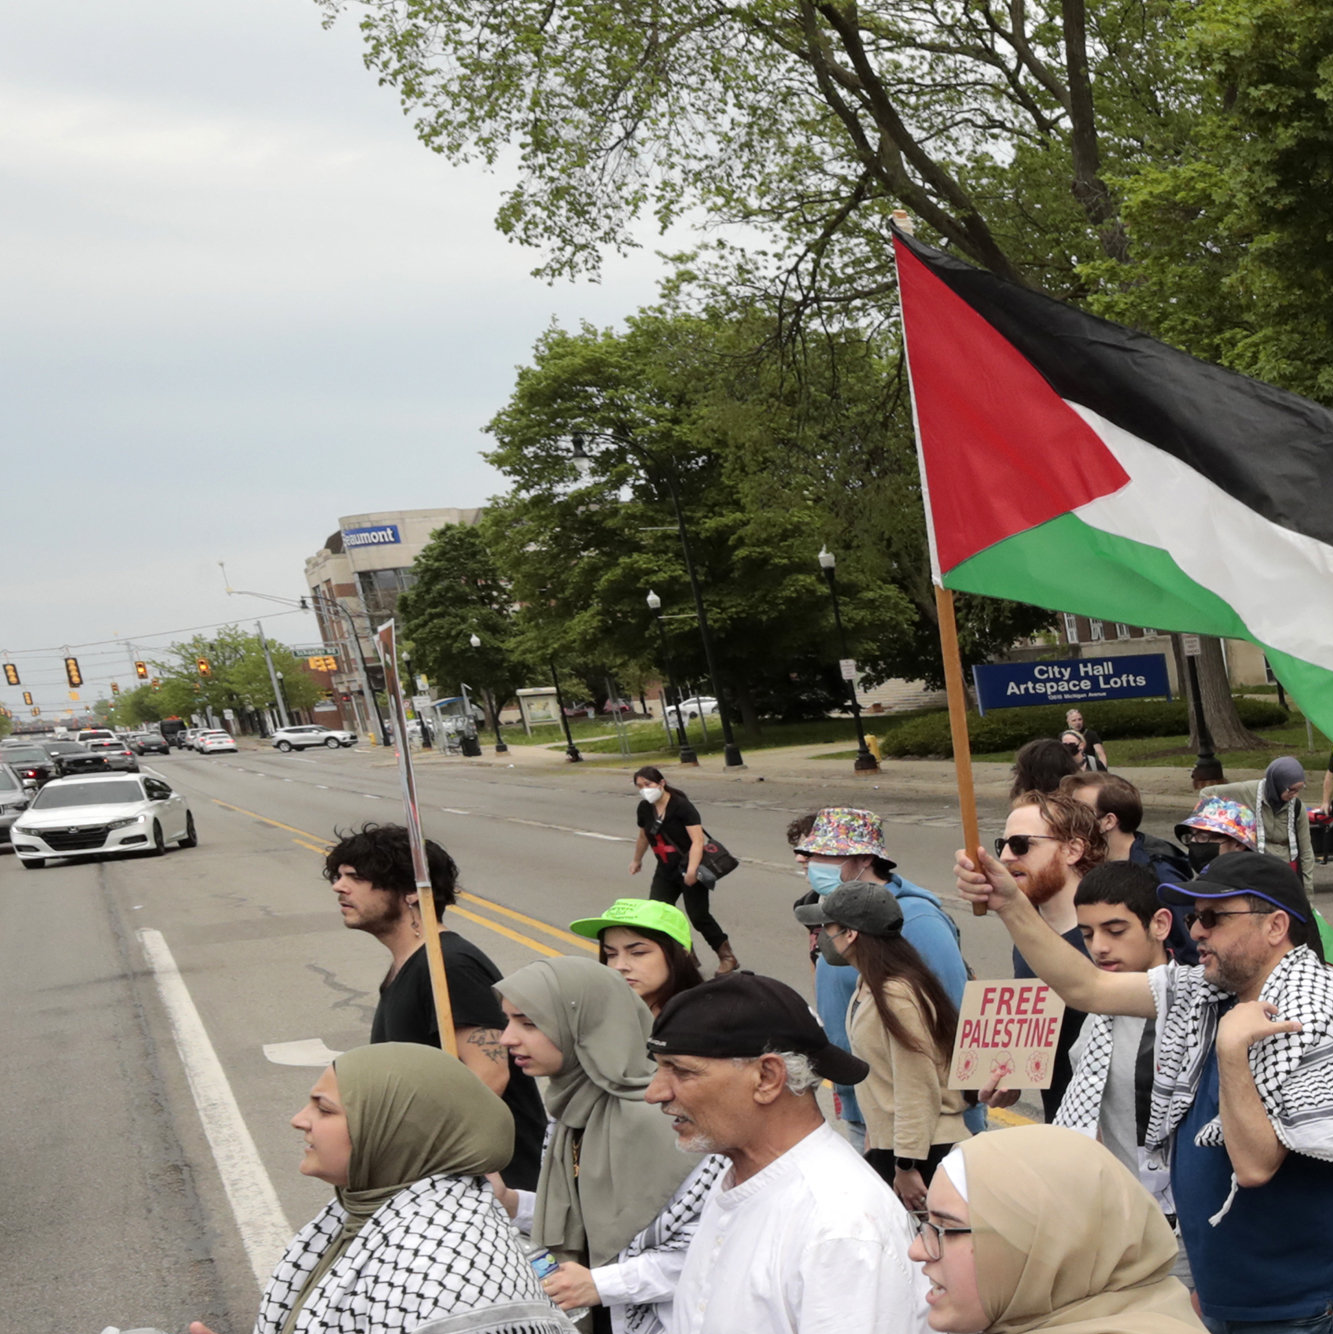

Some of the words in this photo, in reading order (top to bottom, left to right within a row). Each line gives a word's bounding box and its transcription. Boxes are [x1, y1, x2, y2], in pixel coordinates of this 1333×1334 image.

[1034, 665, 1071, 680] City
[1079, 661, 1113, 676] Hall
[1006, 678, 1091, 696] Artspace
[1099, 674, 1146, 689] Lofts
[980, 986, 1050, 1016] FREE
[959, 1017, 1058, 1049] PALESTINE
